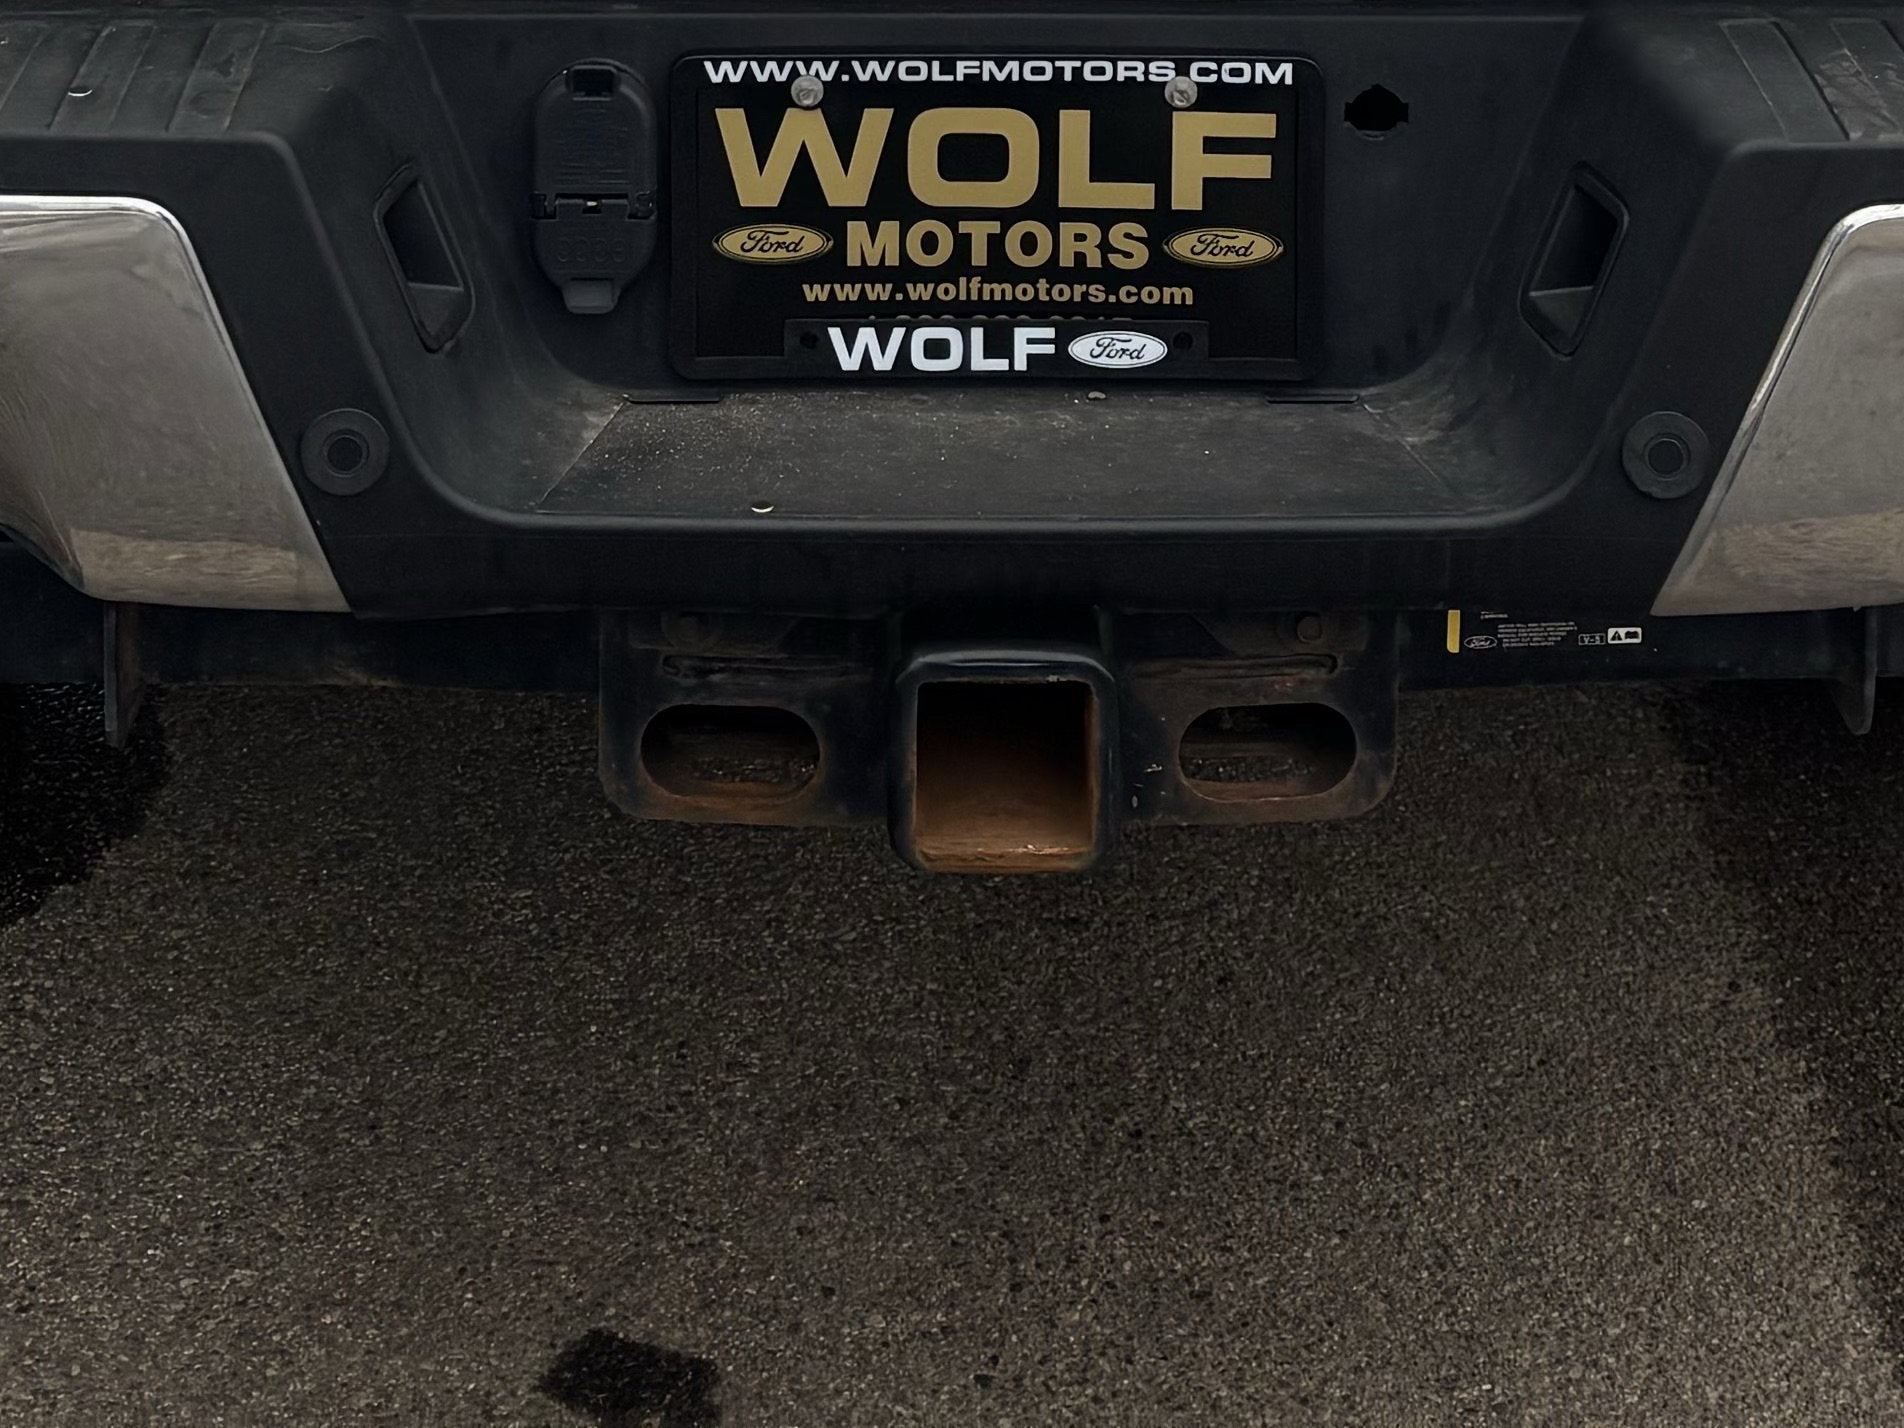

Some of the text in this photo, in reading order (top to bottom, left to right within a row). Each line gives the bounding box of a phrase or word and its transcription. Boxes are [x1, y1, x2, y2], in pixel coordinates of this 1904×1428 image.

[703, 60, 1294, 86] WWW.WOLFMOTORSCOM
[714, 107, 1277, 211] WOLF
[739, 219, 1256, 270] Ford MOTORS Ford
[802, 276, 1194, 305] www.wolfmotors.com
[827, 326, 1147, 372] WOLF Ford
